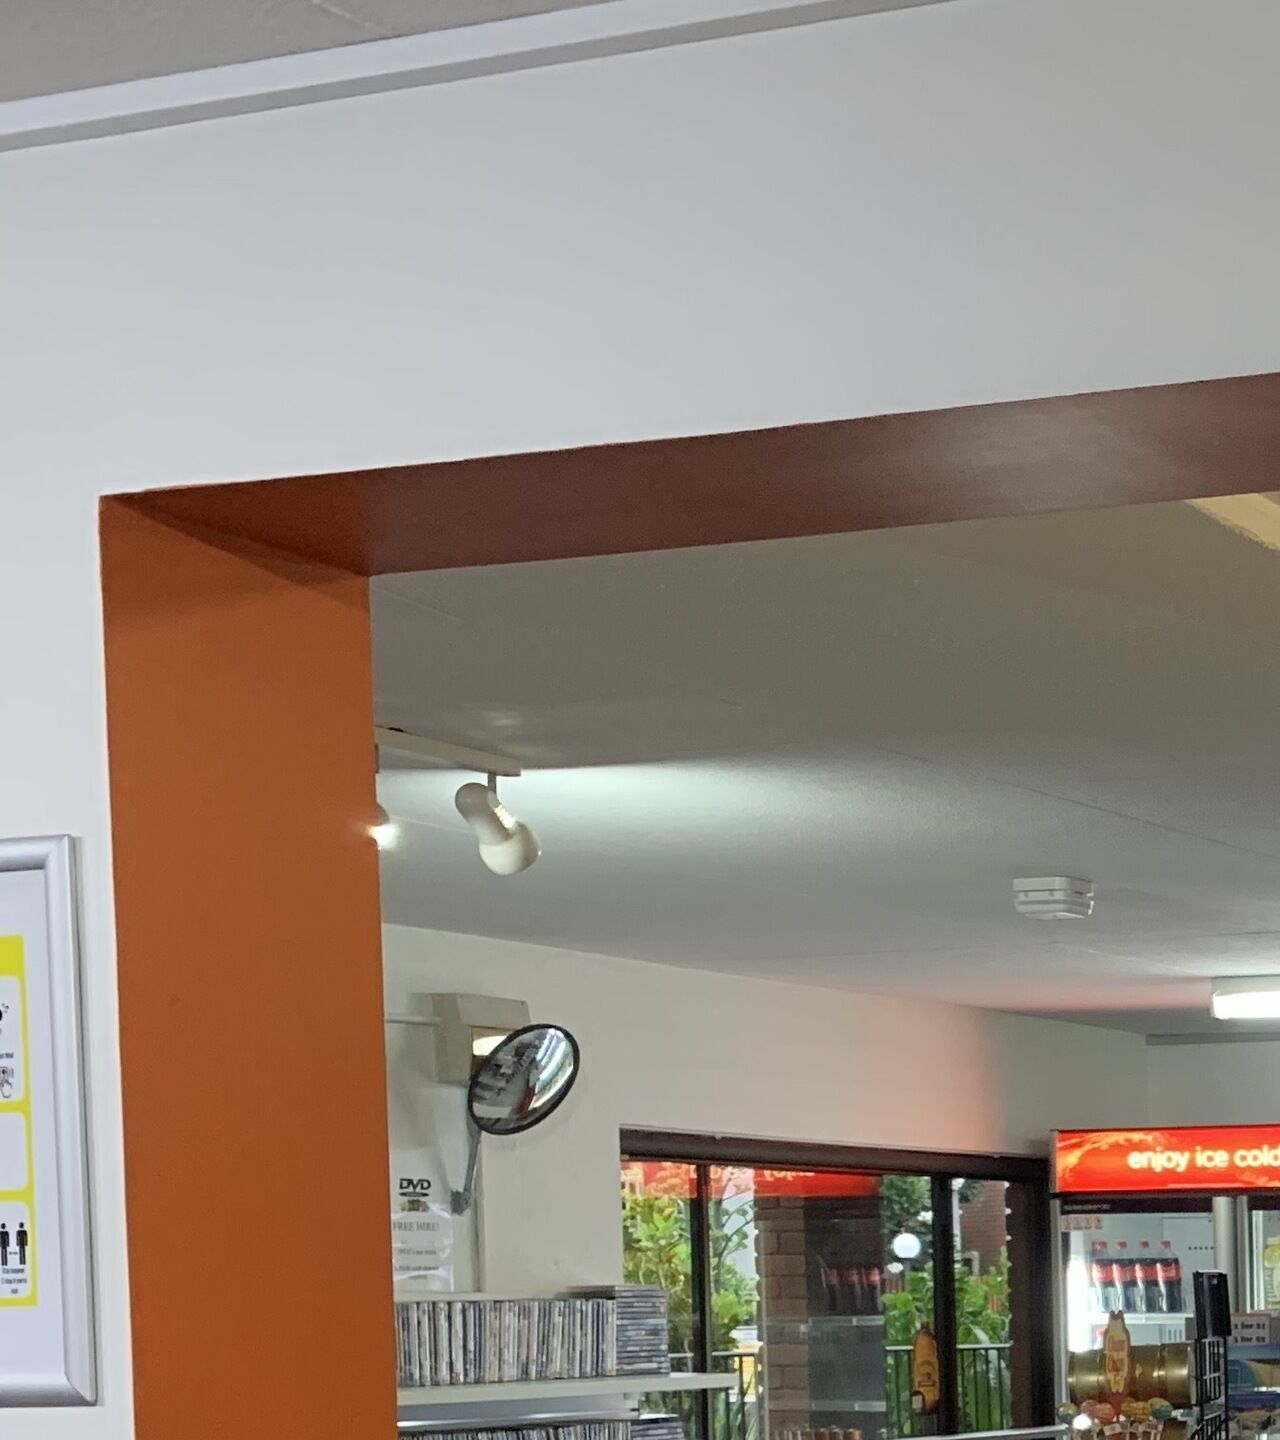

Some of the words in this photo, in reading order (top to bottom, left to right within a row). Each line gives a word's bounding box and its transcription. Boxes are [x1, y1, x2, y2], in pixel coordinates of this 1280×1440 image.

[1127, 1147, 1190, 1172] enjoy
[1195, 1146, 1229, 1168] ice
[399, 1178, 432, 1191] DVD
